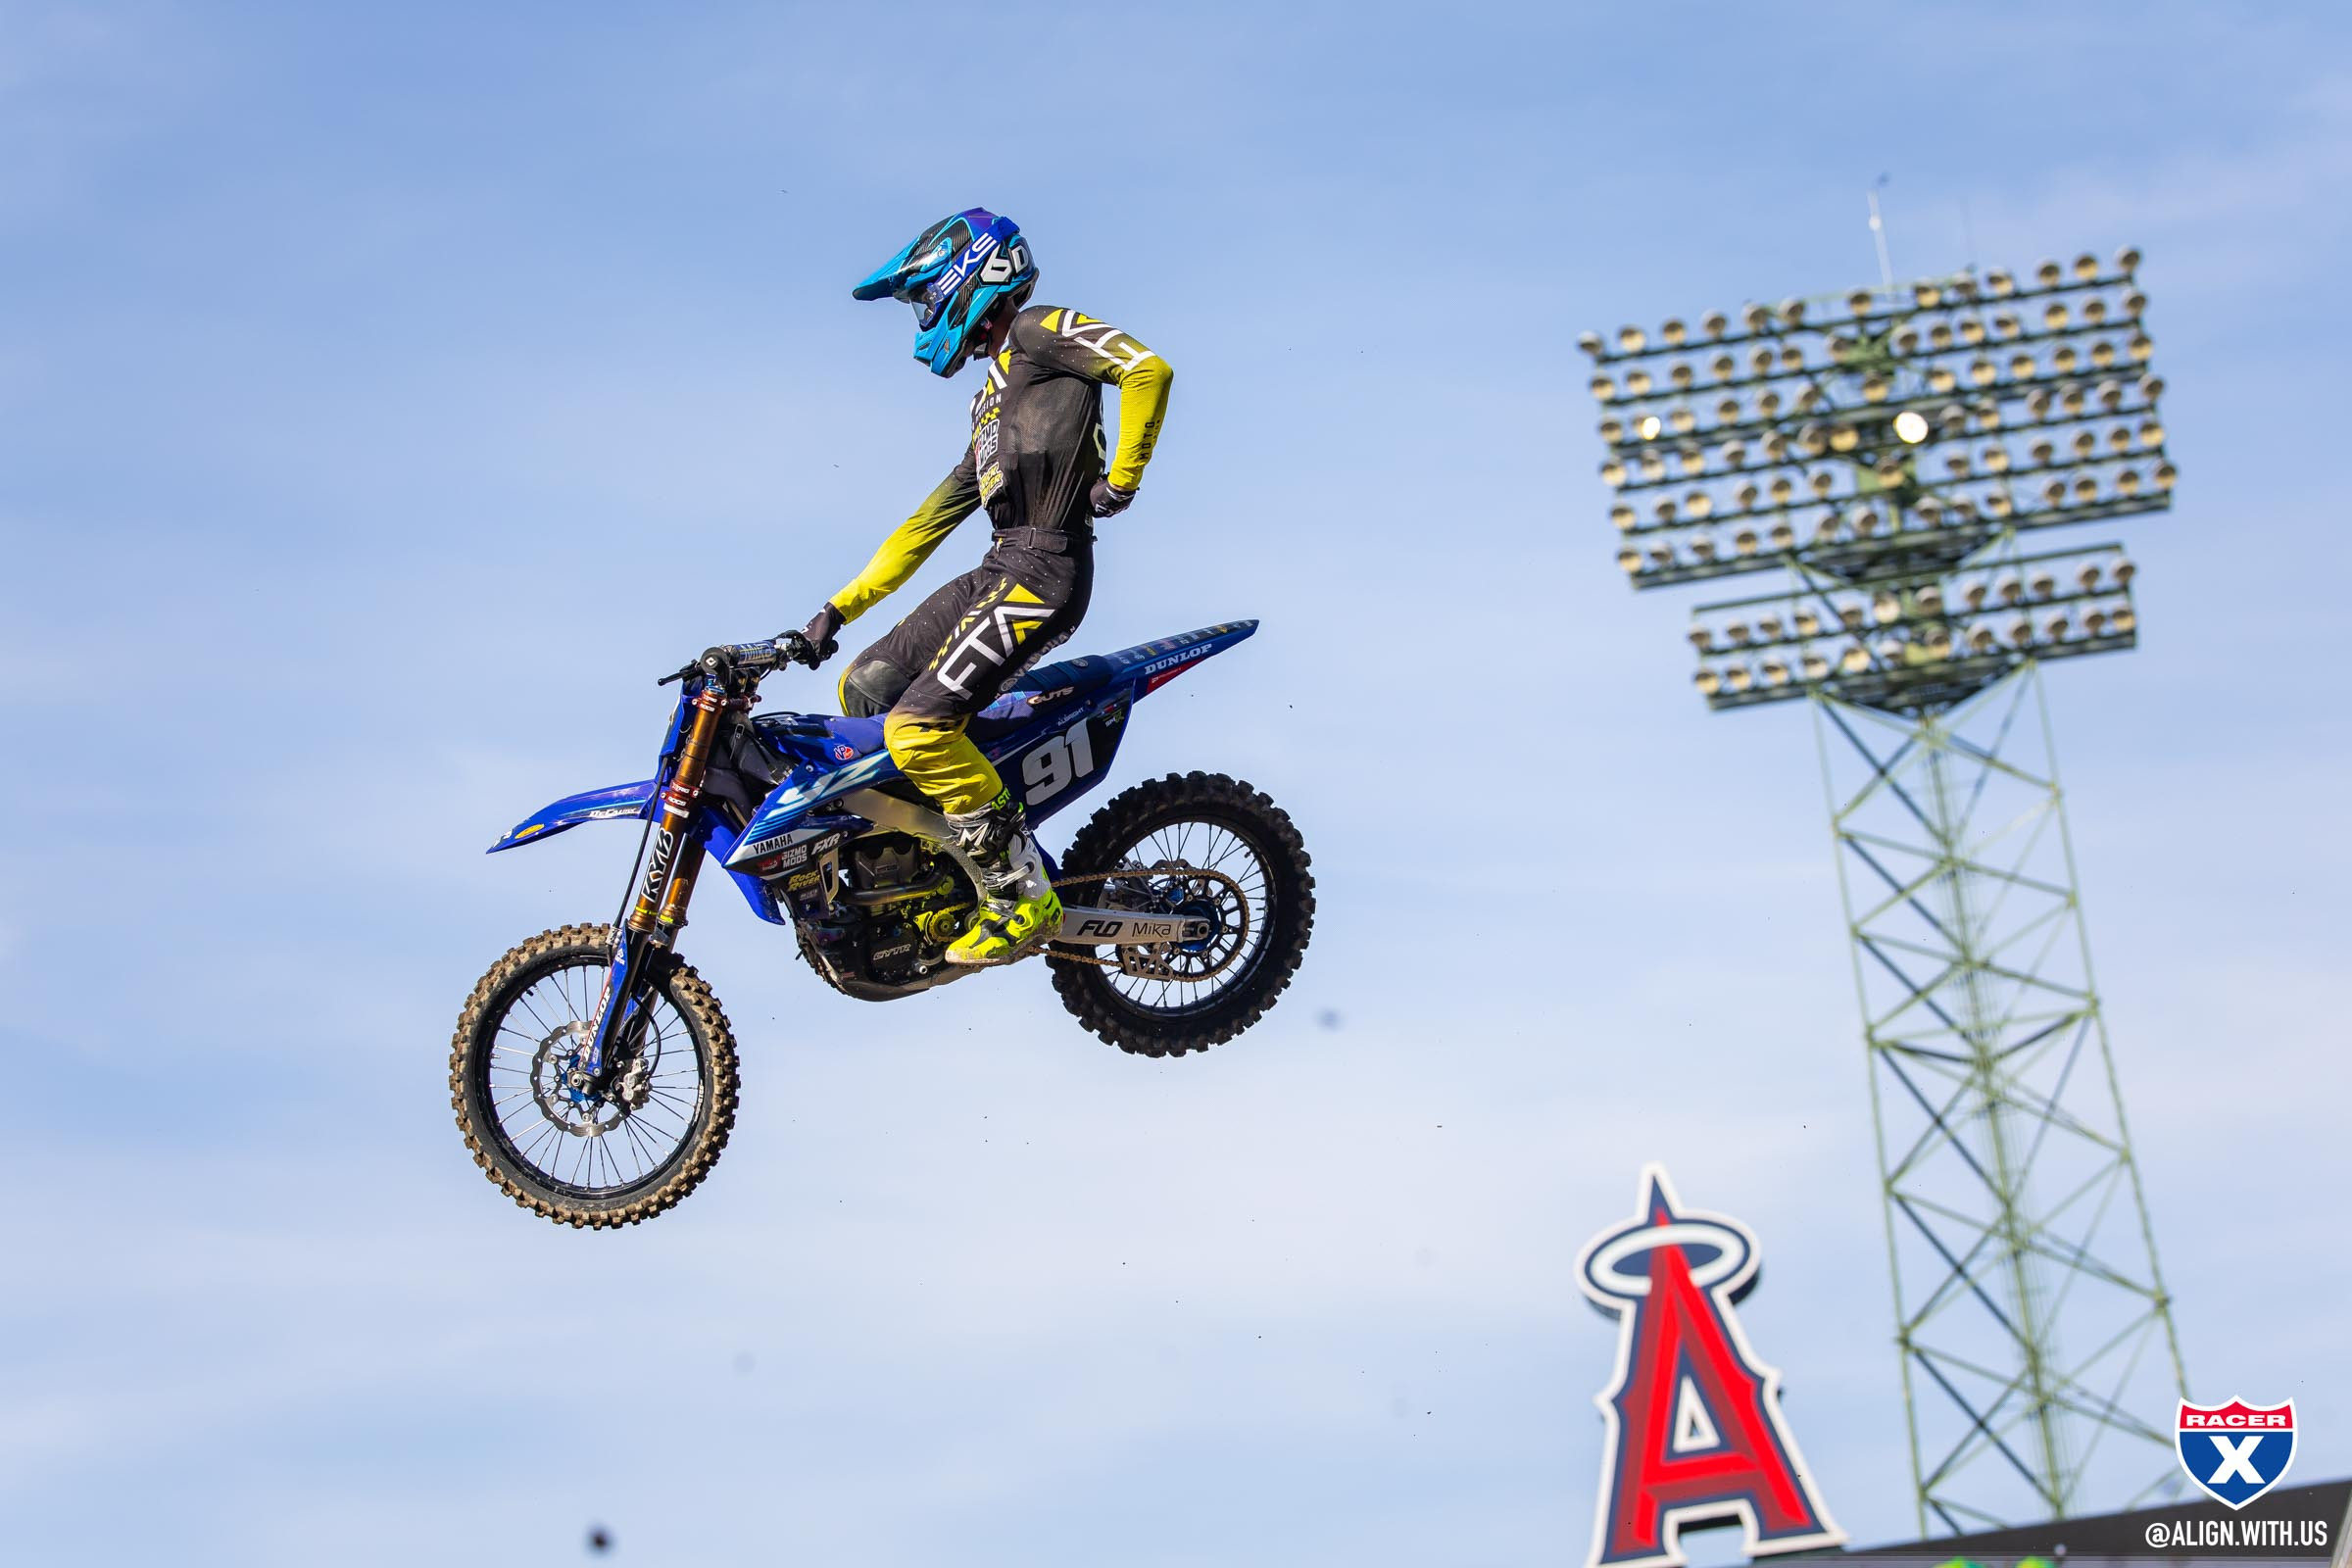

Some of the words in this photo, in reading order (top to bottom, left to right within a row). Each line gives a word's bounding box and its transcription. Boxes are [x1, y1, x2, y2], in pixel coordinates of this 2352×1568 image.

[1139, 420, 1154, 461] MOTO
[1145, 643, 1213, 675] DUNLOP
[1027, 686, 1074, 706] GUTS
[1022, 716, 1095, 806] 91
[753, 834, 793, 855] YAMAHA
[782, 844, 808, 860] GIZMO
[811, 832, 841, 856] FXR
[640, 827, 674, 903] KYB
[783, 853, 808, 868] MODS
[1077, 919, 1123, 938] FLO
[1132, 922, 1172, 938] Mika
[584, 987, 612, 1061] DUNLOP
[1582, 1162, 1846, 1568] A
